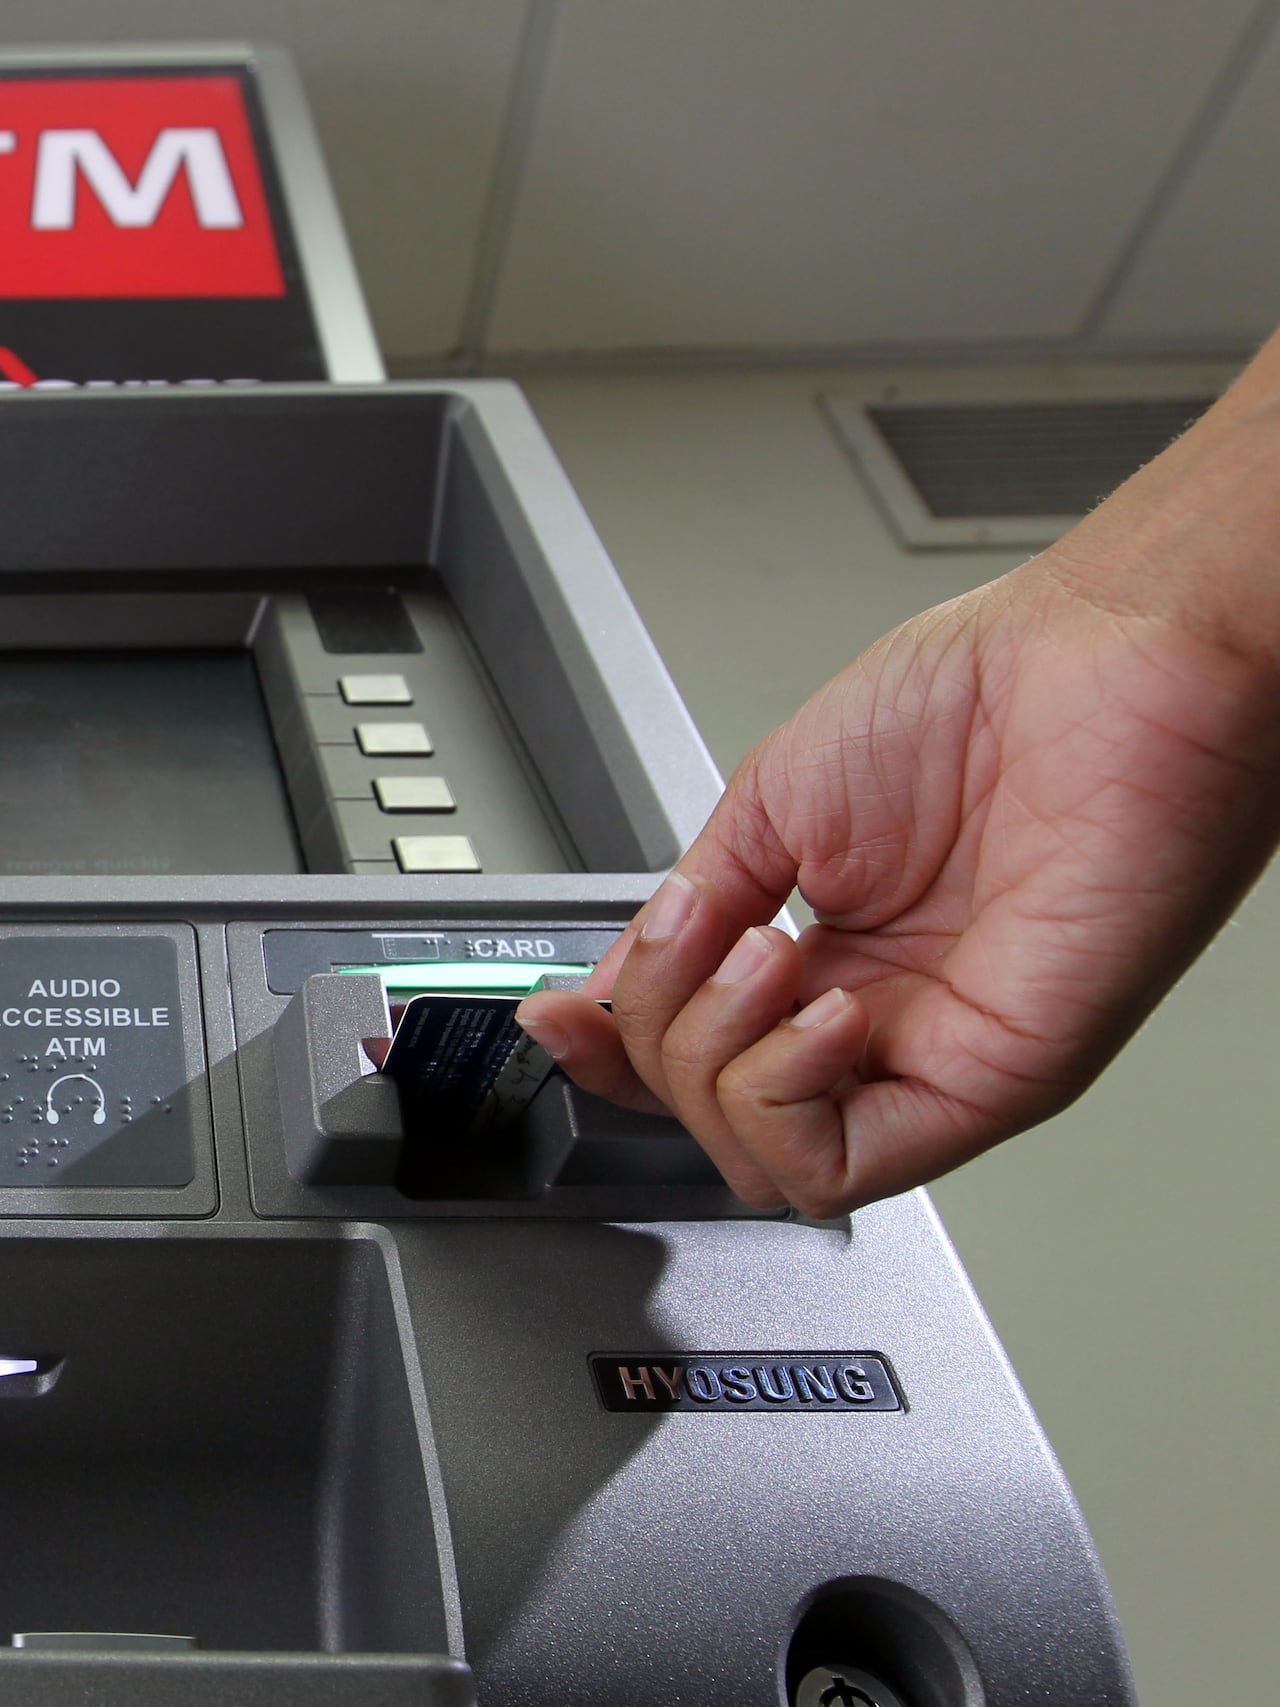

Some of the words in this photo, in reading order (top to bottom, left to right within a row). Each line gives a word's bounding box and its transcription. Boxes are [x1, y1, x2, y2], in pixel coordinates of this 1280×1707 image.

[474, 938, 555, 958] CARD
[27, 978, 121, 998] AUDIO
[45, 1037, 106, 1057] ATM
[618, 1364, 876, 1403] HYOSUNG
